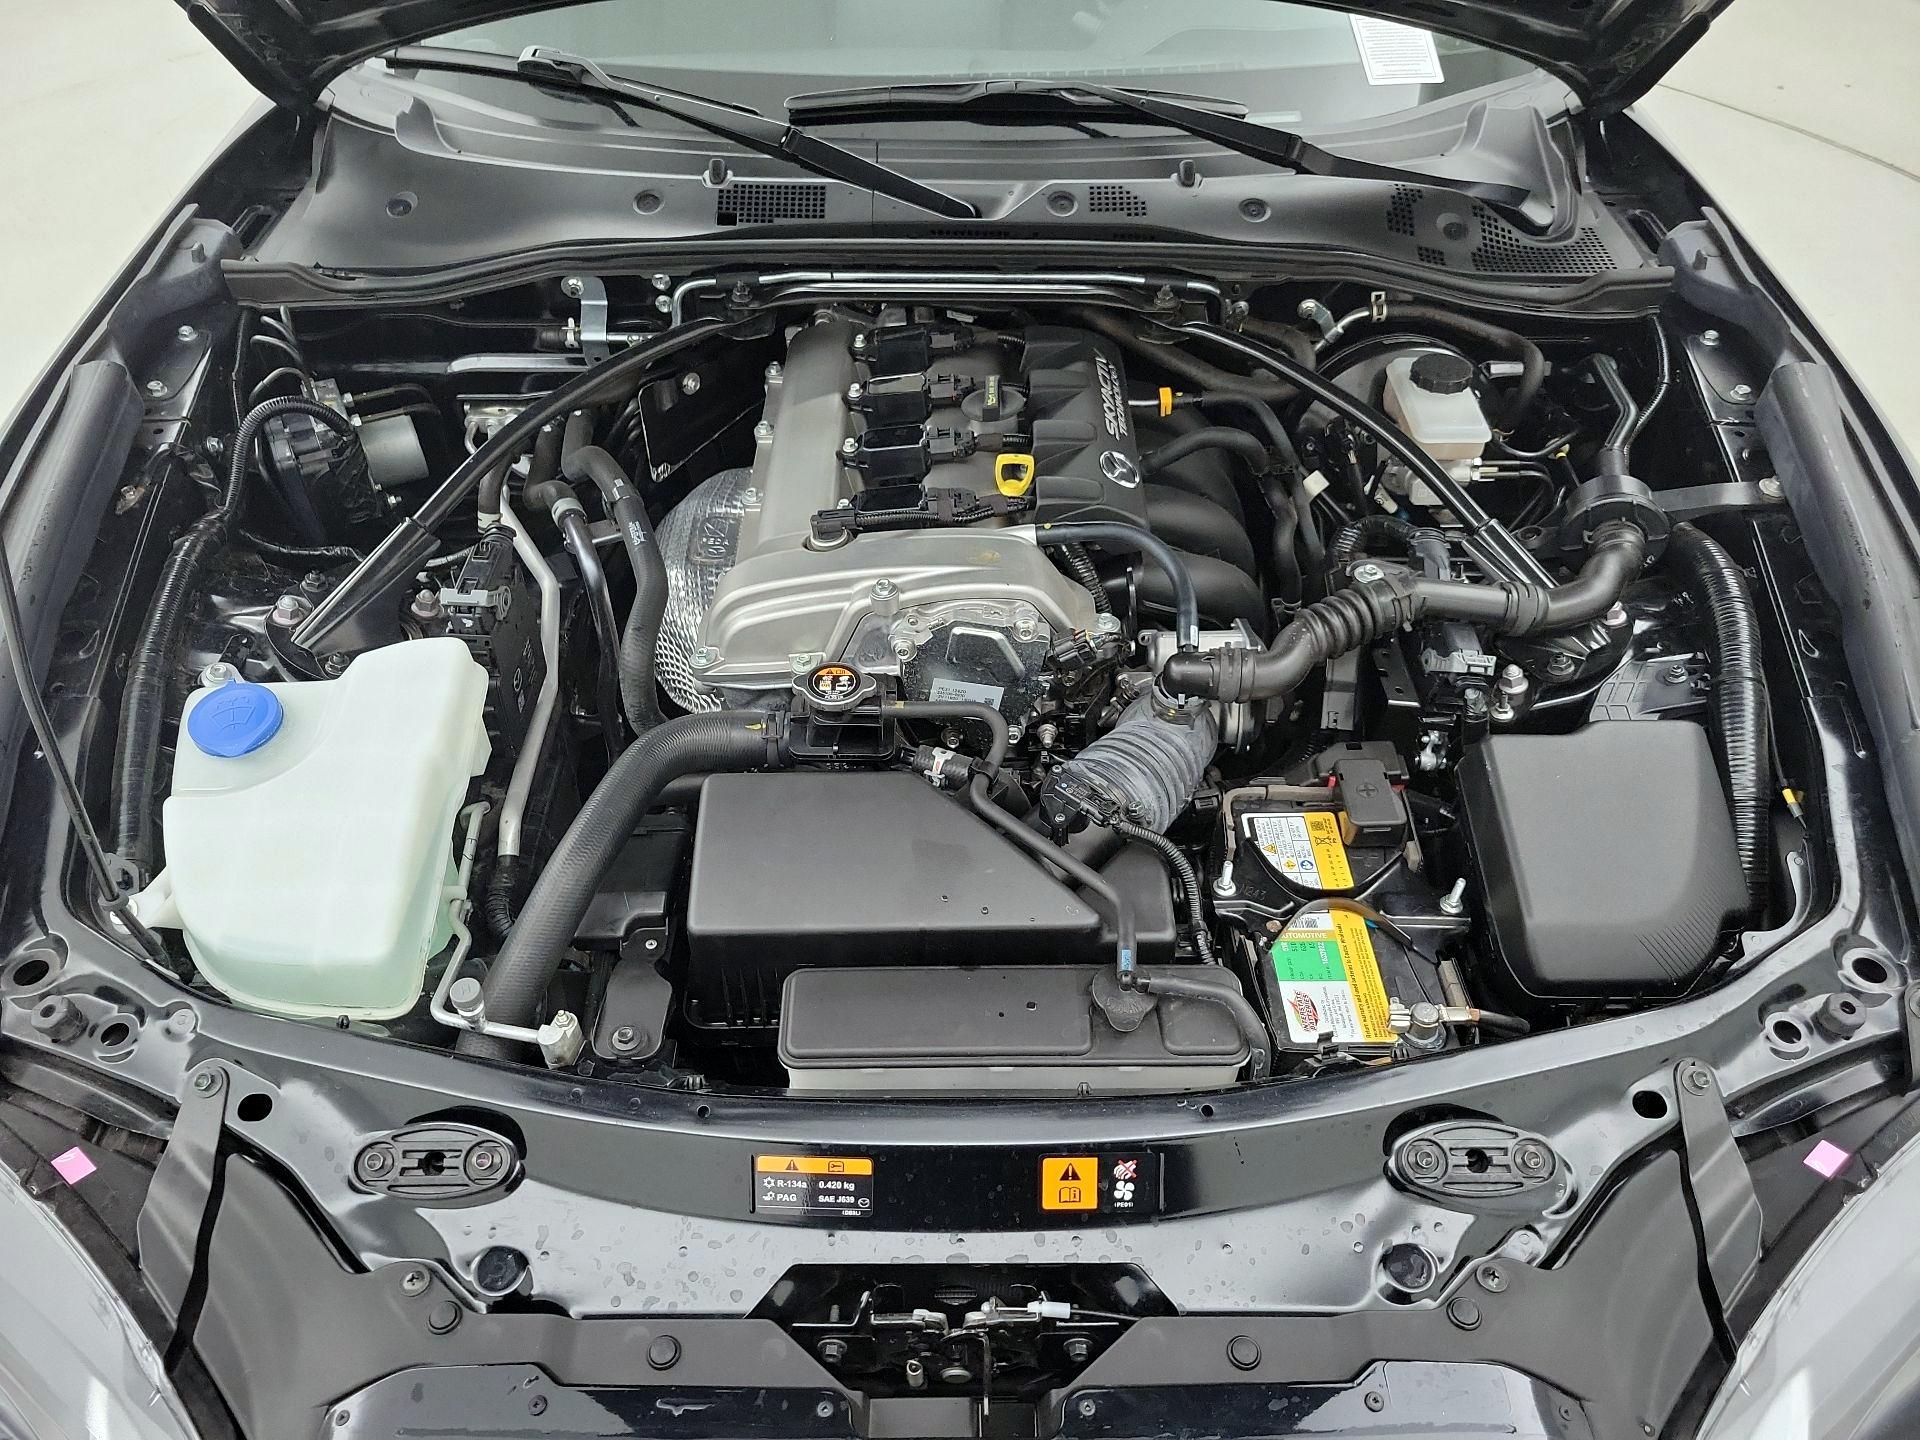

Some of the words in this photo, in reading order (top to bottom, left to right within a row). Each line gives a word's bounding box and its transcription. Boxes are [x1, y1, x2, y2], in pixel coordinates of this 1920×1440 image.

[1093, 347, 1120, 441] SKYACTIV
[1295, 990, 1311, 1031] INTERSTATE
[1303, 993, 1317, 1031] BATTERIES
[776, 1194, 797, 1202] PAG
[818, 1195, 836, 1203] SAE
[777, 1180, 807, 1189] R-134a
[818, 1181, 842, 1190] 0.420
[843, 1181, 855, 1191] kg
